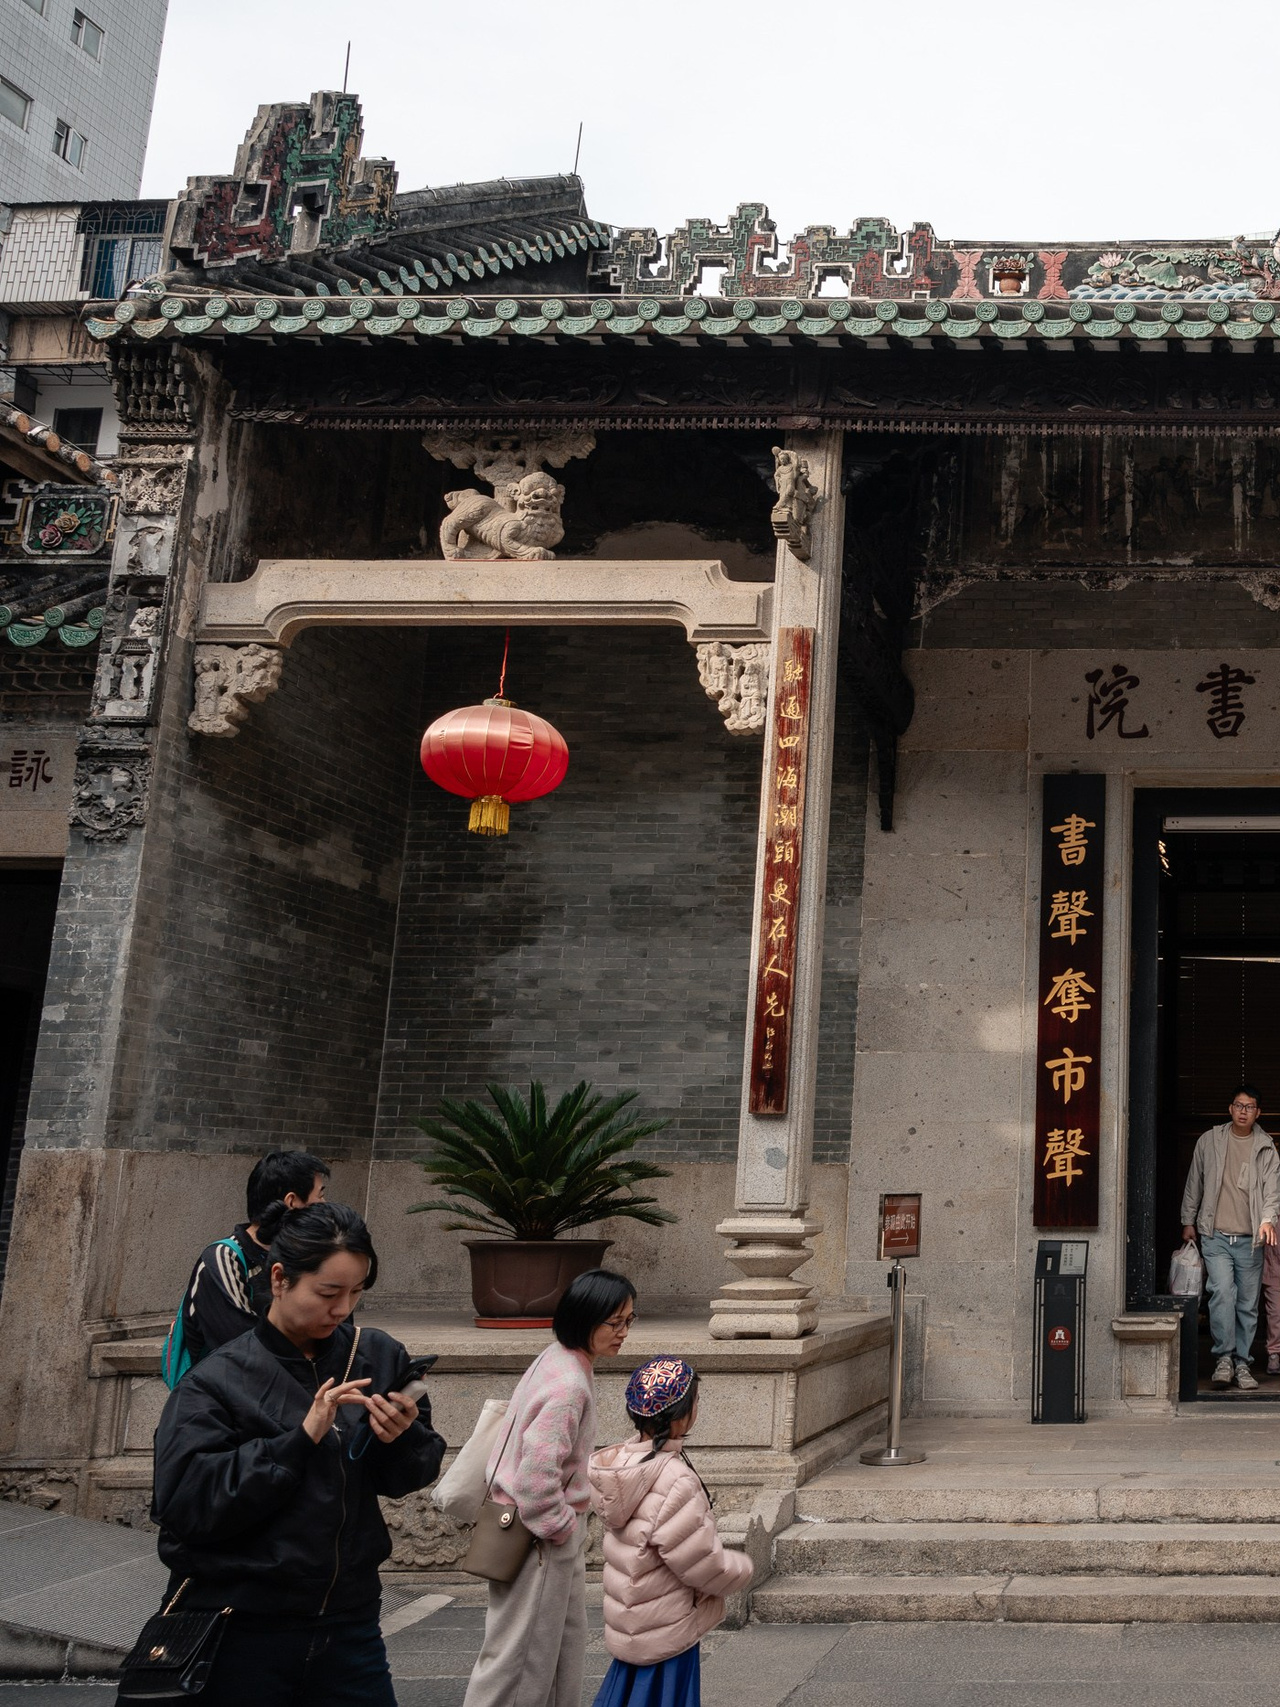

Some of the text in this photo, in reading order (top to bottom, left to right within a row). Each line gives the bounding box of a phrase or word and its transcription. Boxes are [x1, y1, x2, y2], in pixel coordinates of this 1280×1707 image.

[1043, 812, 1097, 1188] 書聲奪市聲
